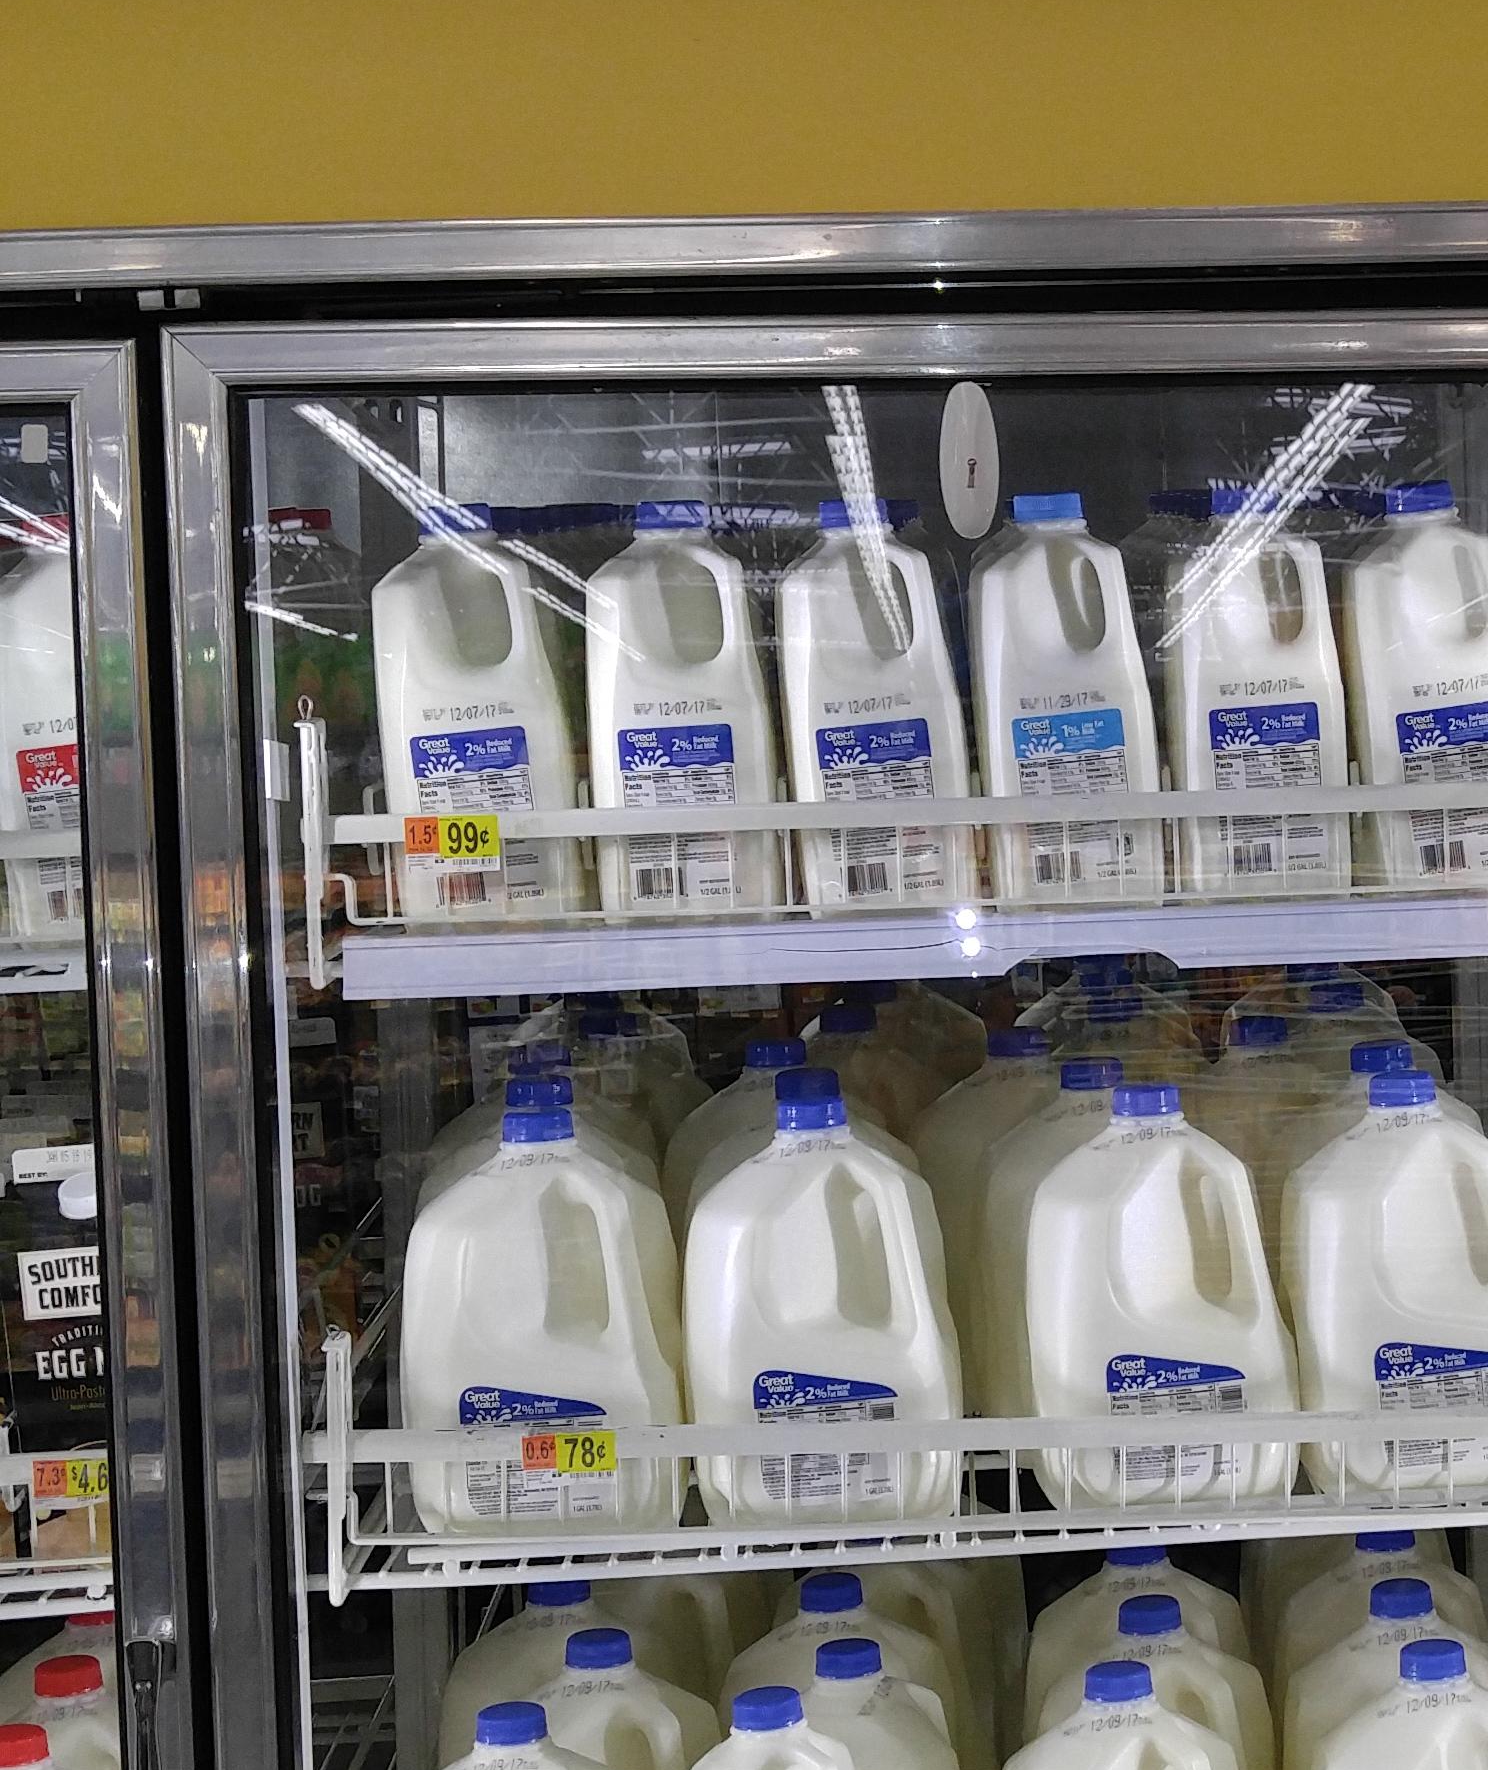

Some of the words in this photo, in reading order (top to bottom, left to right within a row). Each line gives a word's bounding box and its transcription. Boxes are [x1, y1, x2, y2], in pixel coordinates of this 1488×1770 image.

[1217, 712, 1247, 722] Great
[1226, 719, 1247, 727] Value
[1405, 714, 1434, 725] Great
[1020, 719, 1050, 731] Great
[1261, 717, 1281, 730] 2%
[1413, 721, 1434, 730] Value
[1447, 717, 1468, 730] 2%
[824, 730, 855, 741] Great
[1029, 728, 1050, 736] Value
[1061, 724, 1080, 737] 1%
[418, 737, 449, 750] Great
[626, 732, 657, 743] Great
[634, 739, 657, 748] Value
[833, 738, 855, 747] Value
[869, 735, 891, 748] 2%
[427, 746, 449, 755] Value
[464, 740, 486, 755] 2%
[671, 739, 693, 752] 2%
[25, 751, 56, 763] Great
[447, 821, 490, 856] 99¢
[28, 1255, 101, 1286] SOUTH
[1379, 1347, 1413, 1358] Great
[36, 1347, 86, 1380] EGG
[1111, 1359, 1145, 1370] Great
[1387, 1355, 1413, 1364] Value
[1424, 1357, 1445, 1370] 2%
[1120, 1367, 1145, 1377] Value
[1157, 1370, 1178, 1383] 2%
[759, 1376, 793, 1387] Great
[767, 1384, 793, 1393] Value
[805, 1387, 827, 1399] 2%
[465, 1391, 500, 1403] Great
[474, 1399, 500, 1409] Value
[512, 1403, 534, 1416] 2%
[563, 1435, 606, 1469] 78¢
